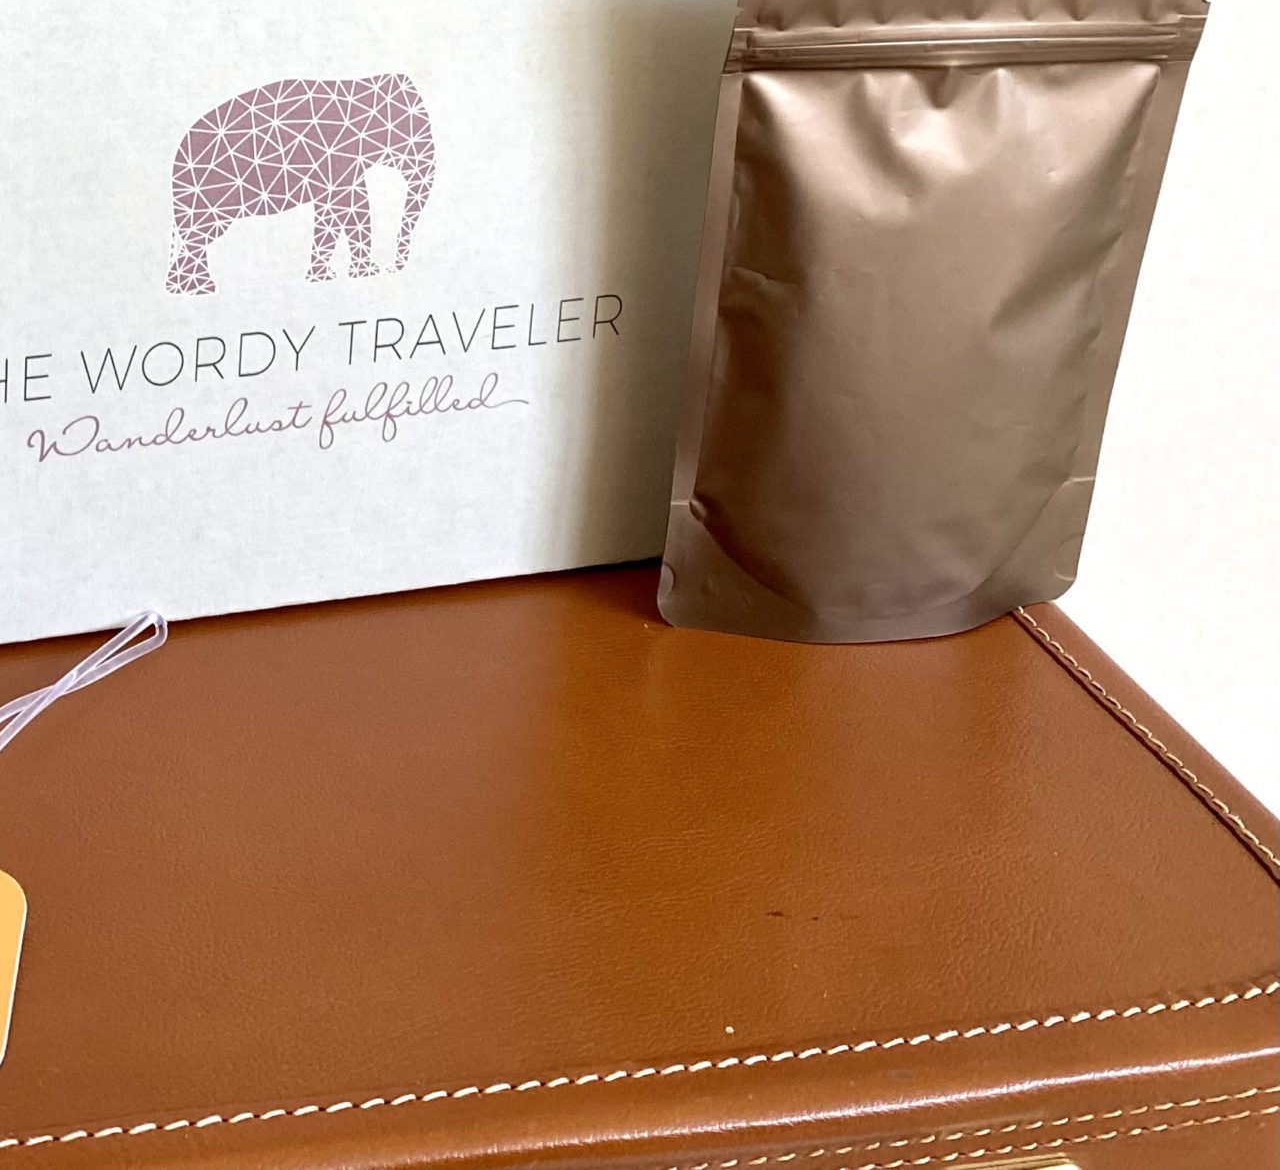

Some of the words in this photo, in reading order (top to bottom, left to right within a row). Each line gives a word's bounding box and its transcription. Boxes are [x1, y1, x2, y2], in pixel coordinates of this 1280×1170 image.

[80, 325, 317, 394] WORDY
[339, 294, 624, 366] TRAVELER
[27, 396, 313, 463] Wanderlust
[320, 372, 530, 450] fulfilled
